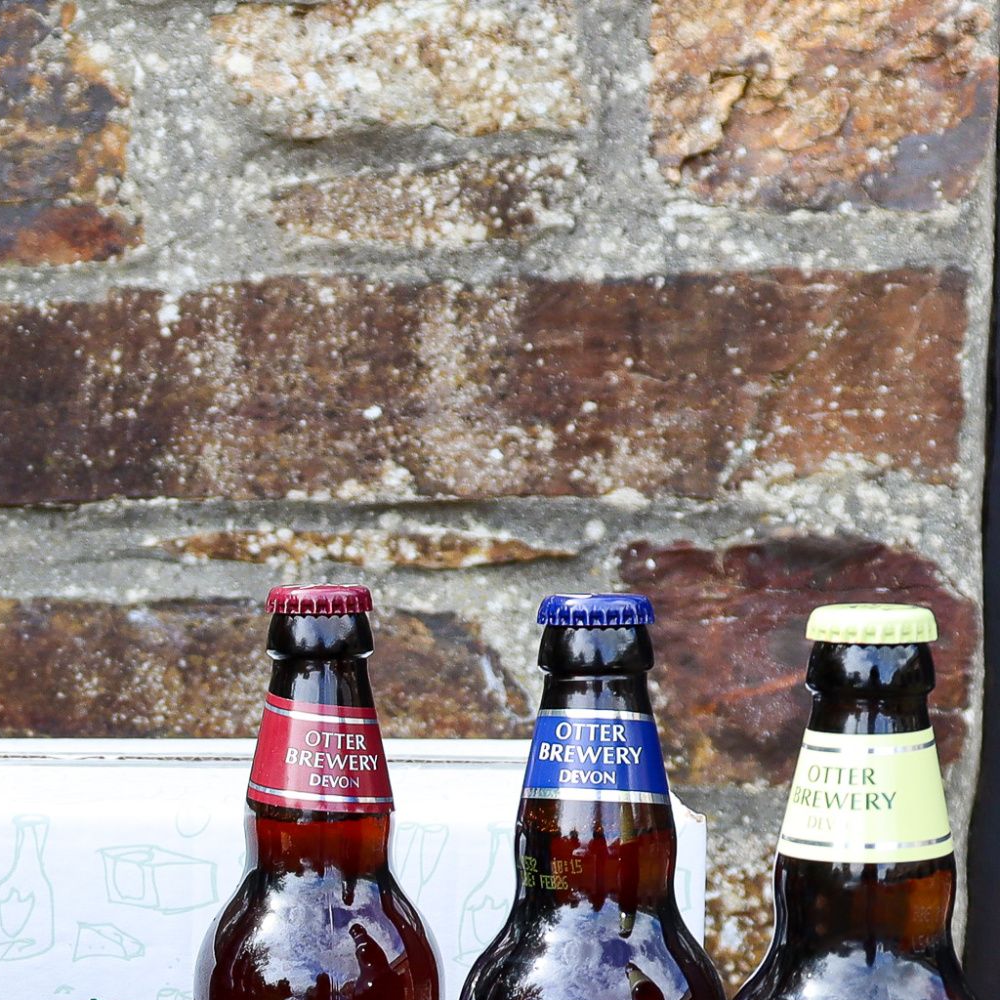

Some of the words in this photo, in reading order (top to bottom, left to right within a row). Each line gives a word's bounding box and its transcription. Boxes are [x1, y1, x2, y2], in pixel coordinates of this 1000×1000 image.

[305, 730, 367, 750] OTTER
[555, 721, 626, 742] OTTER
[285, 748, 378, 771] BREWERY
[538, 742, 643, 765] BREWERY
[309, 773, 360, 788] DEVON
[559, 769, 616, 785] DEVON
[807, 765, 877, 786] OTTER
[793, 785, 897, 811] BREWERY
